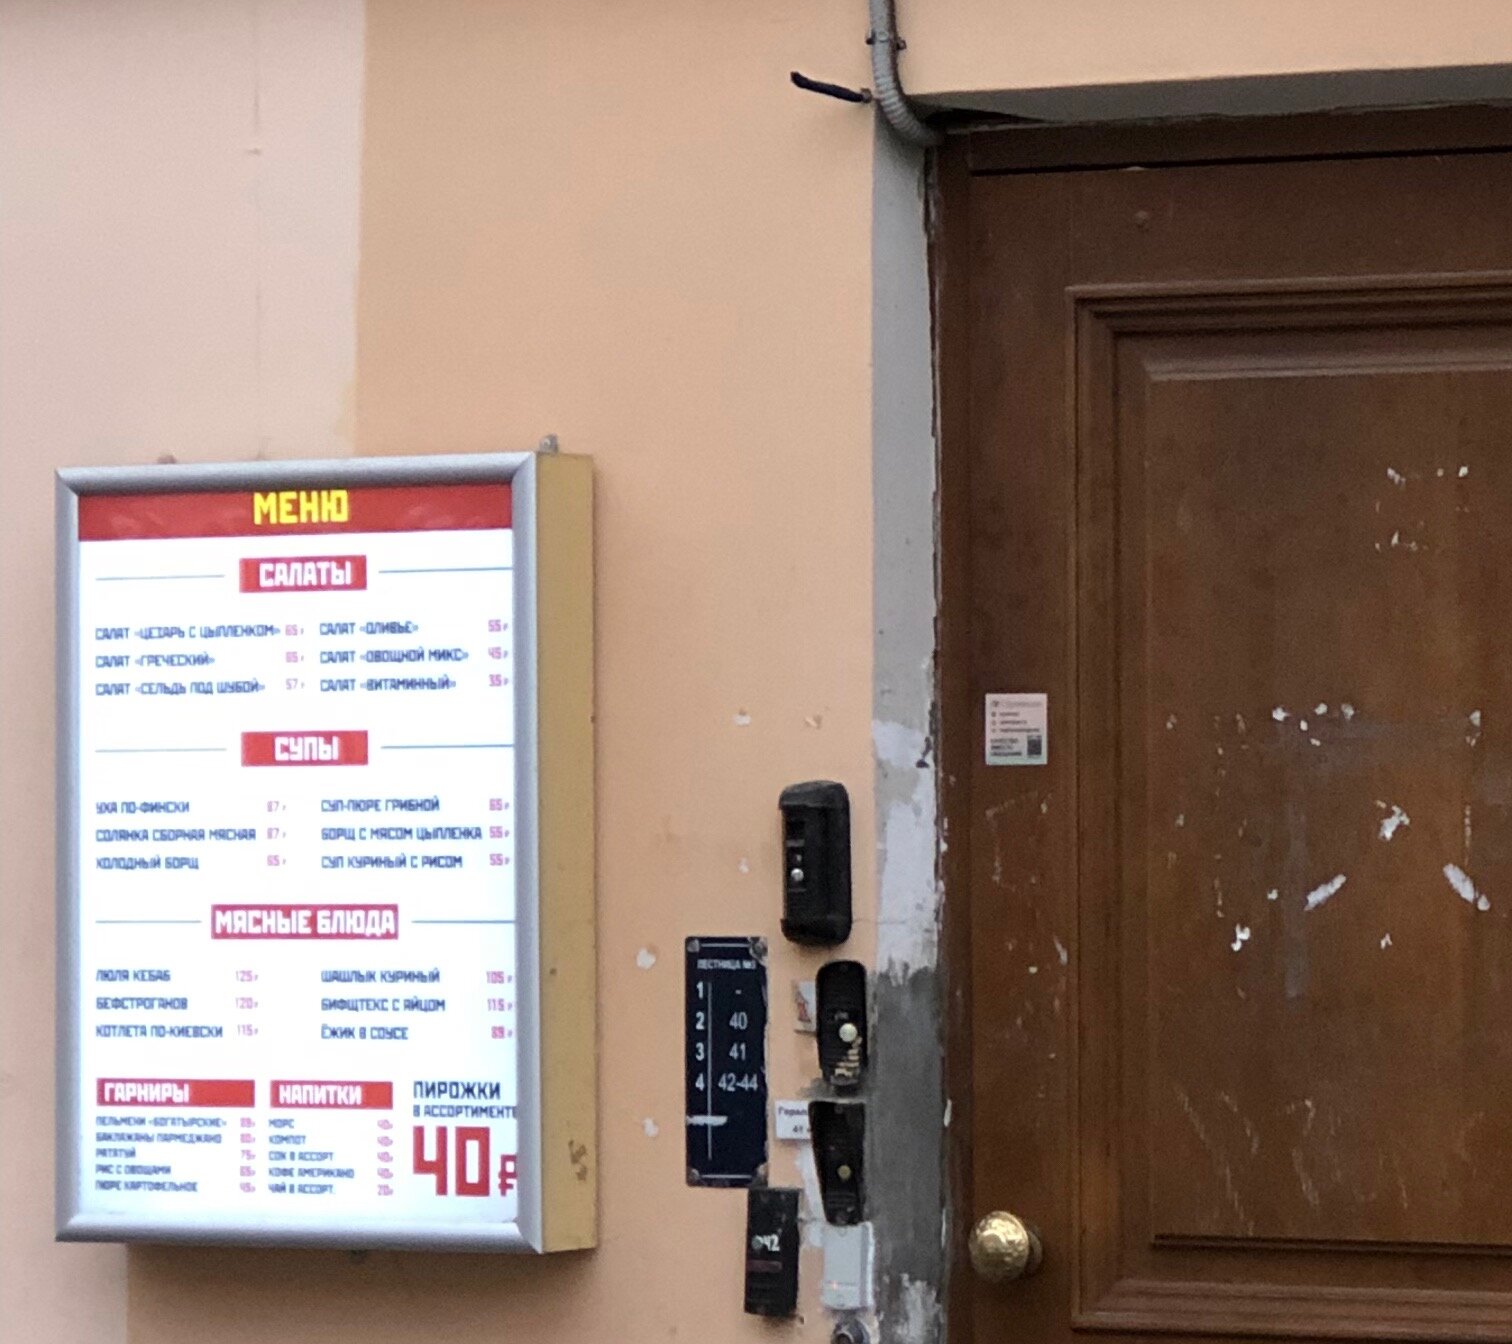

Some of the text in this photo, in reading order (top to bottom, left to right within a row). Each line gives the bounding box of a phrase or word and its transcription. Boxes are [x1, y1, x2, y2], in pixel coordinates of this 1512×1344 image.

[253, 489, 349, 525] МЕНЮ
[259, 560, 352, 587] САЛАТЫ
[95, 627, 130, 640] САЛАТ
[189, 626, 196, 638] С
[319, 622, 356, 636] САЛАТ
[95, 655, 130, 668] САЛАТ
[320, 650, 356, 664] САЛАТ
[95, 683, 130, 696] САЛАТ
[190, 681, 213, 695] ПОД
[320, 678, 356, 692] САЛАТ
[274, 735, 339, 761] СУПЫ
[96, 801, 117, 814] УХА
[121, 800, 190, 814] ПО-ФИНСКИ
[321, 799, 381, 812] СУП-ПЮРЕ
[385, 795, 440, 812] ГРИБНОЙ
[96, 829, 149, 842] СОЛЯНКА
[152, 828, 205, 842] СБОРНАЯ
[209, 828, 256, 841] МЯСНАЯ
[321, 827, 356, 841] БОРЩ
[359, 827, 367, 840] С
[370, 827, 413, 840] МЯСОМ
[416, 826, 482, 841] ЦЫПЛЕНКА
[96, 854, 161, 870] ХОЛОДНЫЙ
[165, 856, 199, 870] БОРЩ
[321, 855, 344, 869] СУП
[347, 852, 407, 869] КУРИНЫЙ
[410, 855, 418, 868] С
[421, 855, 463, 868] РИСОМ
[215, 910, 396, 937] МЯСНЫЕ БЛЮДА
[96, 969, 129, 982] ЛЮЛЯ
[133, 969, 171, 982] КЕБАБ
[321, 970, 376, 983] ШАШЛЫК
[380, 967, 440, 983] КУРИНЫЙ
[696, 981, 704, 999] 1
[96, 997, 188, 1010] БЕФСТРОГАНОВ
[392, 999, 400, 1011] С
[403, 996, 446, 1013] ЯЙЦОМ
[696, 1012, 748, 1030] 2 40
[96, 1025, 147, 1038] КОТЛЕТА
[151, 1025, 223, 1038] ПО-КИЕВСКИ
[321, 1023, 355, 1039] ЁЖИК
[370, 1027, 409, 1040] СОУСЕ
[696, 1043, 746, 1061] 3 41
[413, 1080, 501, 1100] ПИРОЖКИ
[695, 1073, 758, 1091] 4 42-44
[104, 1082, 190, 1103] ГАРНИРЫ
[278, 1084, 363, 1105] НАПИТКИ
